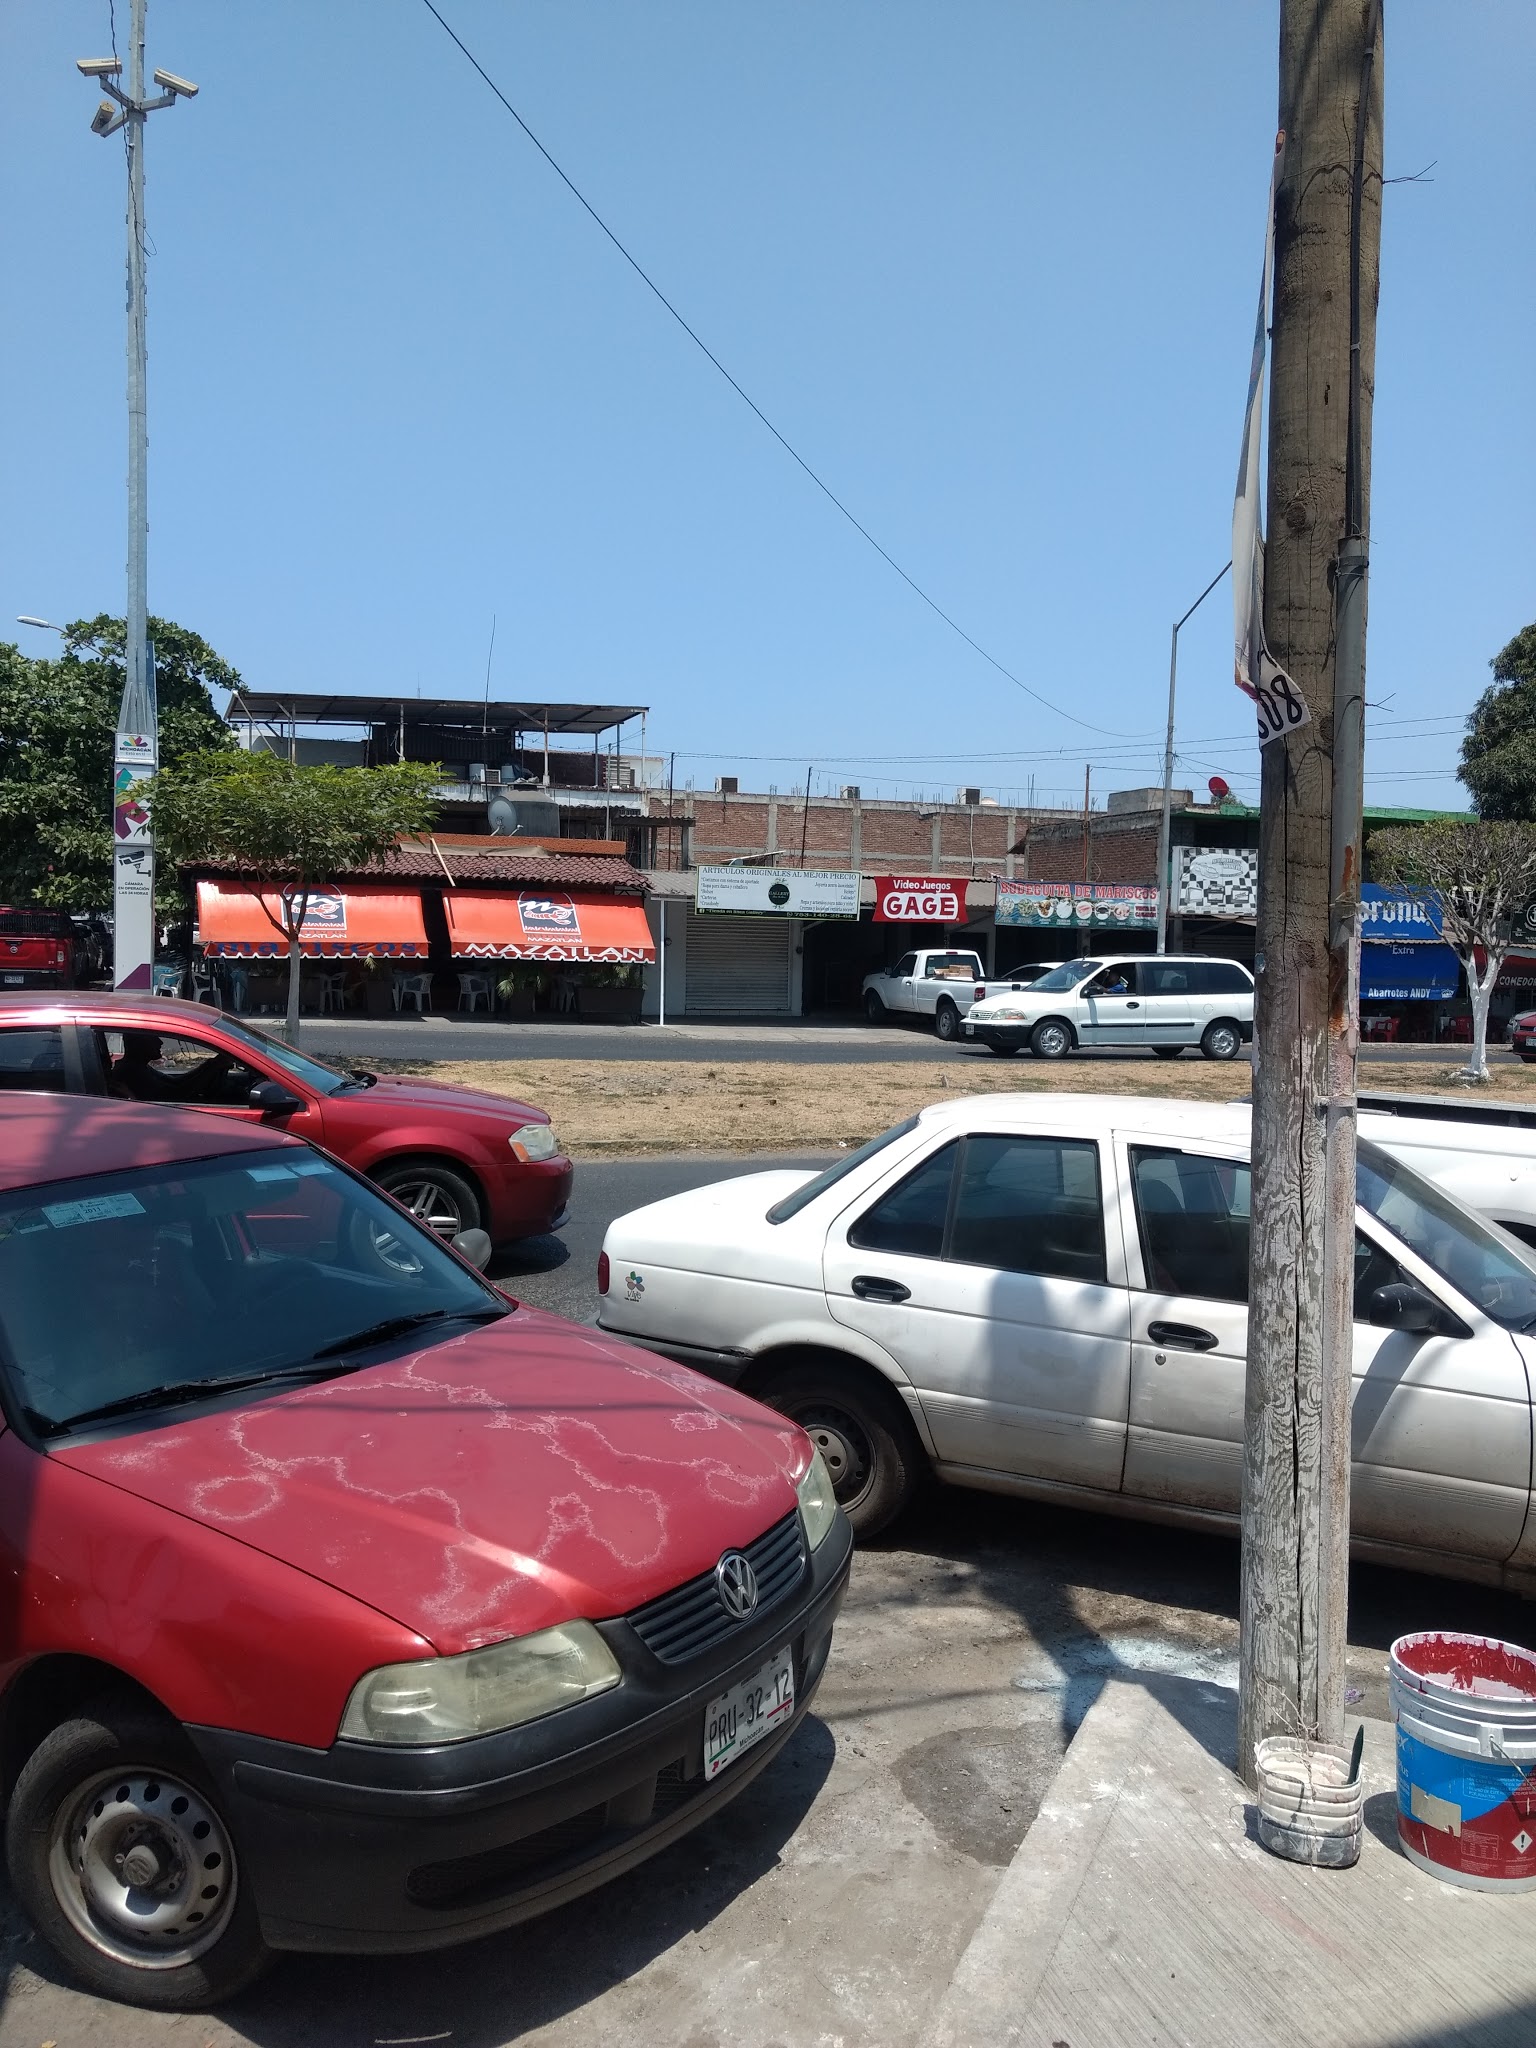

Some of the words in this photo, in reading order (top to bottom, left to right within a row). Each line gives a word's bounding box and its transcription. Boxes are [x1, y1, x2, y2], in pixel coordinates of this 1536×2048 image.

[702, 867, 745, 875] ARTICULOS
[746, 868, 791, 877] ORIGINALES
[893, 879, 920, 889] Video
[920, 880, 951, 893] Juegos
[1000, 881, 1071, 897] BODEGUITA
[1075, 884, 1092, 898] DE
[1095, 886, 1157, 900] MARISCOS
[886, 895, 955, 916] GAGE
[1359, 900, 1427, 924] orona
[216, 942, 417, 953] maiscos
[464, 943, 644, 959] MAZATLAN
[1391, 944, 1415, 955] Extra
[1367, 987, 1408, 998] Abarrotes
[1409, 988, 1431, 998] ANDY
